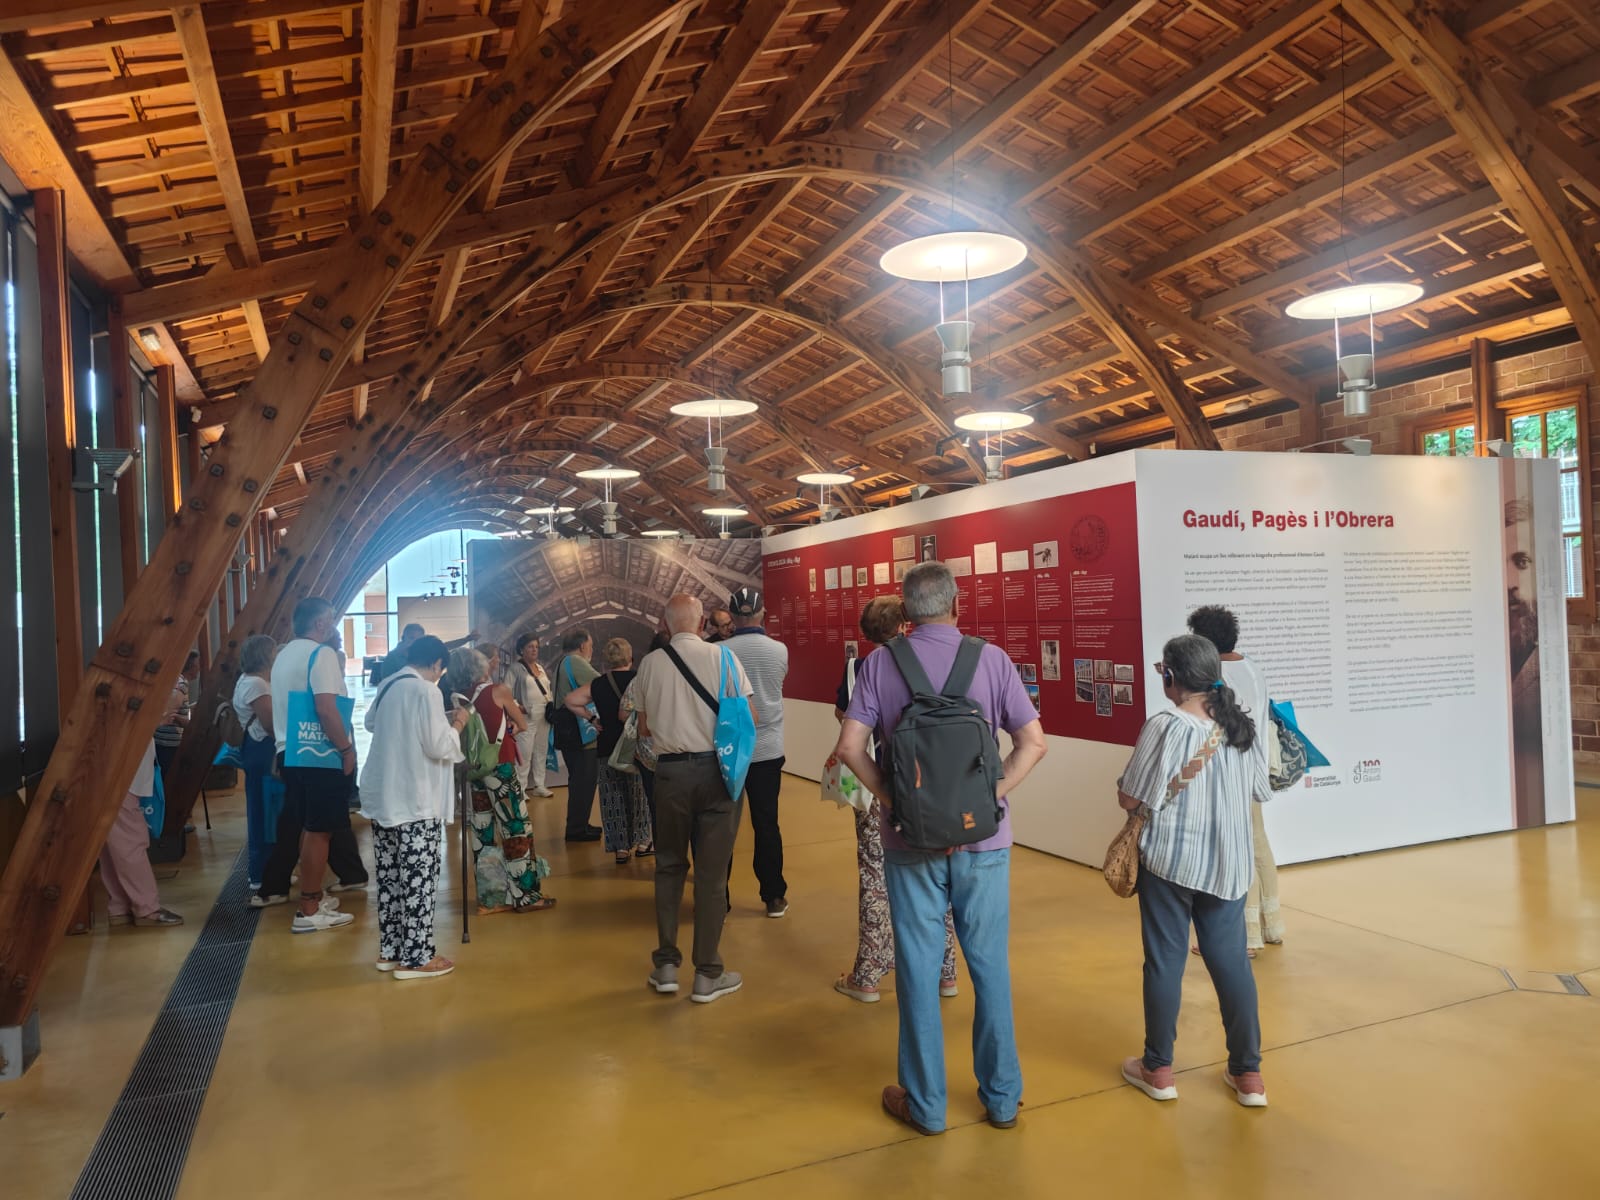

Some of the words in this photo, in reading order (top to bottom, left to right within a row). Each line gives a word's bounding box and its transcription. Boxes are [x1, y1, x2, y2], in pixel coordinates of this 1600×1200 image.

[1183, 509, 1245, 531] Gaudí,
[1252, 509, 1308, 532] Pagès
[1313, 511, 1319, 528] i
[1325, 510, 1394, 528] l'Obrera
[298, 721, 321, 731] VISI
